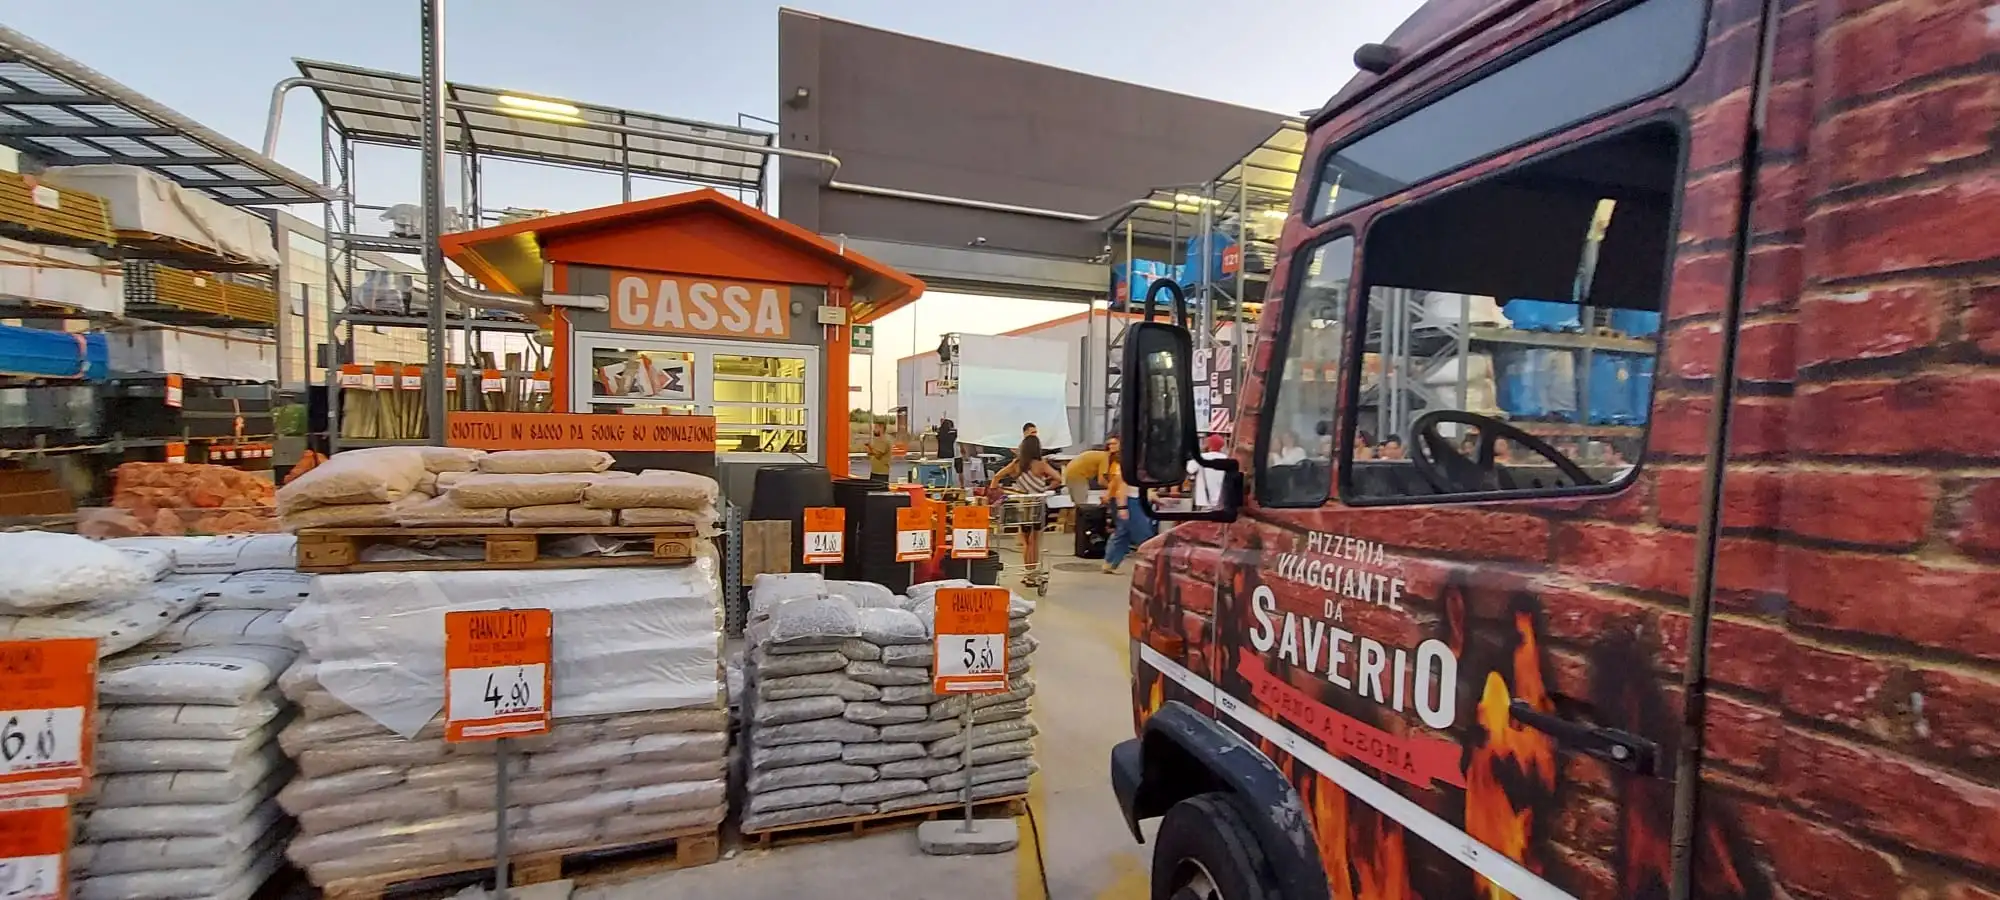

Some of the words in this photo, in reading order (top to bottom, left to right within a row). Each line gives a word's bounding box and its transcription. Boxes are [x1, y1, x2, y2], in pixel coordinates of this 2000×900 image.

[617, 276, 784, 335] CASSA
[451, 422, 502, 440] CIOTTOLI
[511, 423, 522, 440] IN
[530, 424, 563, 441] SACCO
[570, 424, 583, 440] DA
[591, 424, 625, 441] 500KG
[633, 424, 646, 441] SU
[653, 424, 715, 443] ORDINAZIONE
[1308, 531, 1384, 566] PIZZERIA
[1277, 552, 1405, 612] VIAGGIANTE
[469, 613, 527, 640] GRANULATO
[1324, 598, 1343, 622] DA
[963, 638, 994, 669] 5.50
[1250, 585, 1458, 729] SAVERIO
[483, 671, 530, 709] 4.90
[1261, 679, 1315, 725] FORNO
[1323, 716, 1333, 737] A
[1341, 723, 1416, 774] LEGNA
